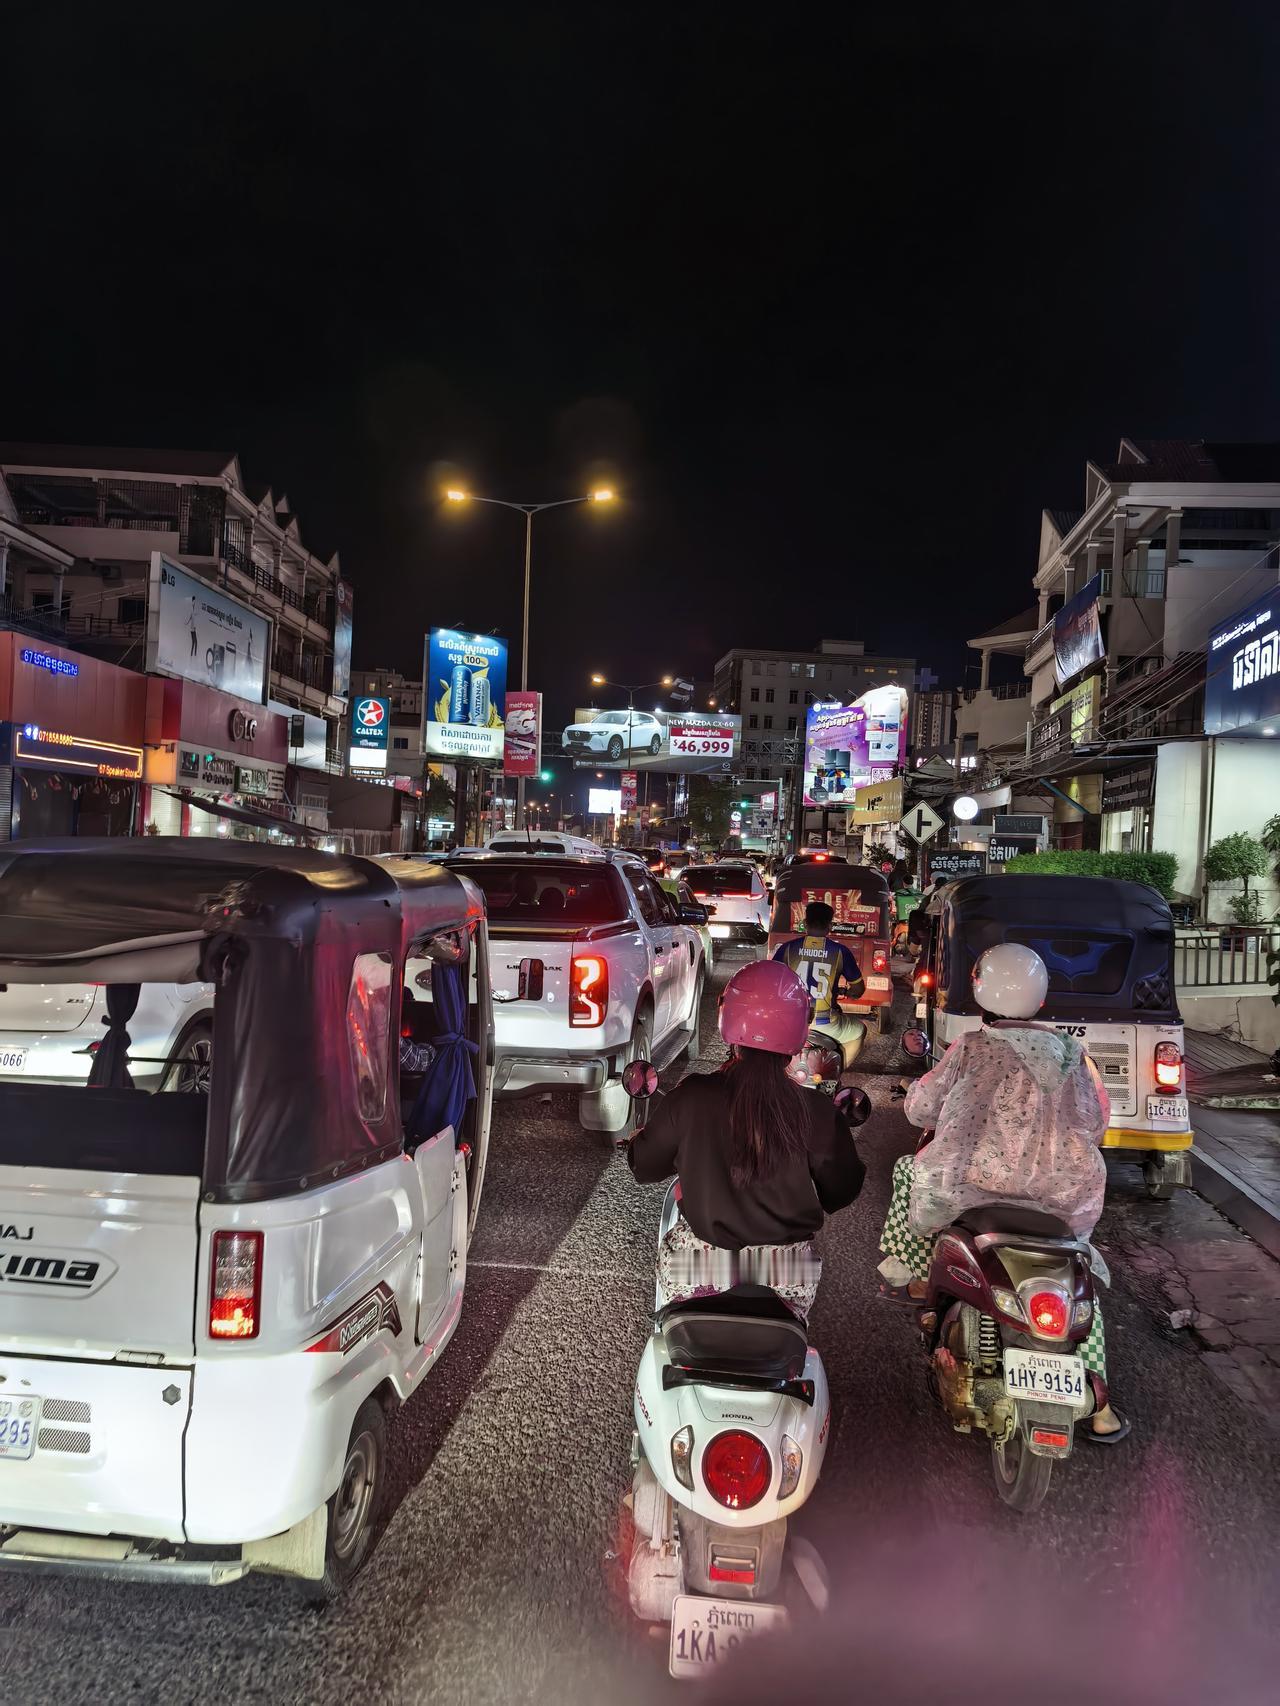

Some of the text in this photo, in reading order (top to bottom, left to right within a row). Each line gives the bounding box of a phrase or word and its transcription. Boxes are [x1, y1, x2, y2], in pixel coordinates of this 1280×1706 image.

[167, 573, 175, 587] LG
[455, 671, 463, 714] VATTANAC
[356, 728, 383, 736] CALTEX
[673, 739, 730, 755] $46,999
[799, 948, 828, 958] KHUOCH
[0, 1223, 33, 1240] AJ
[0, 1253, 100, 1282] ima
[1008, 1368, 1082, 1395] 1HY-9154
[721, 1413, 754, 1421] HONDA
